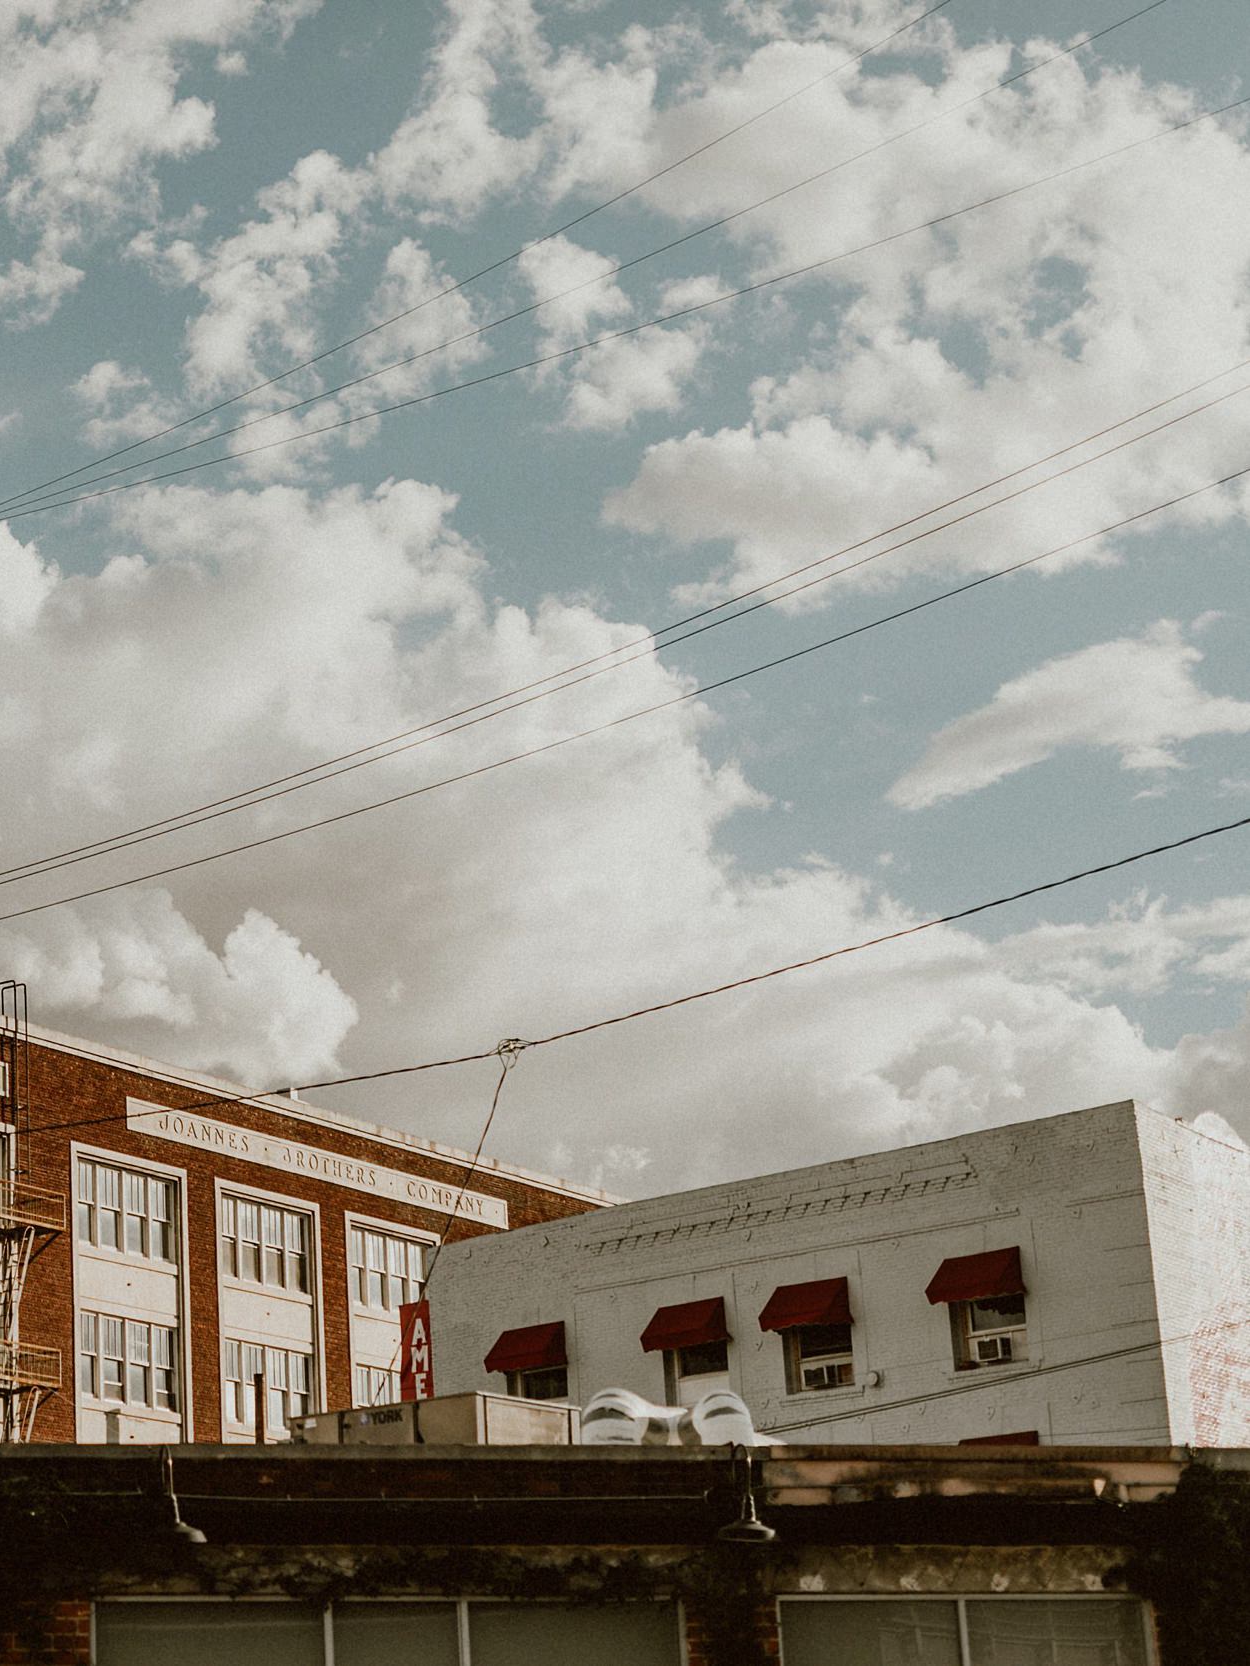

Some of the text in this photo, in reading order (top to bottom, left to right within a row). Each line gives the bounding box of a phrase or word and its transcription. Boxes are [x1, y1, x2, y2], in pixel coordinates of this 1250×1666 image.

[159, 1115, 250, 1153] JOANNES
[406, 1180, 485, 1216] COMPANY
[371, 1408, 404, 1425] YORK
